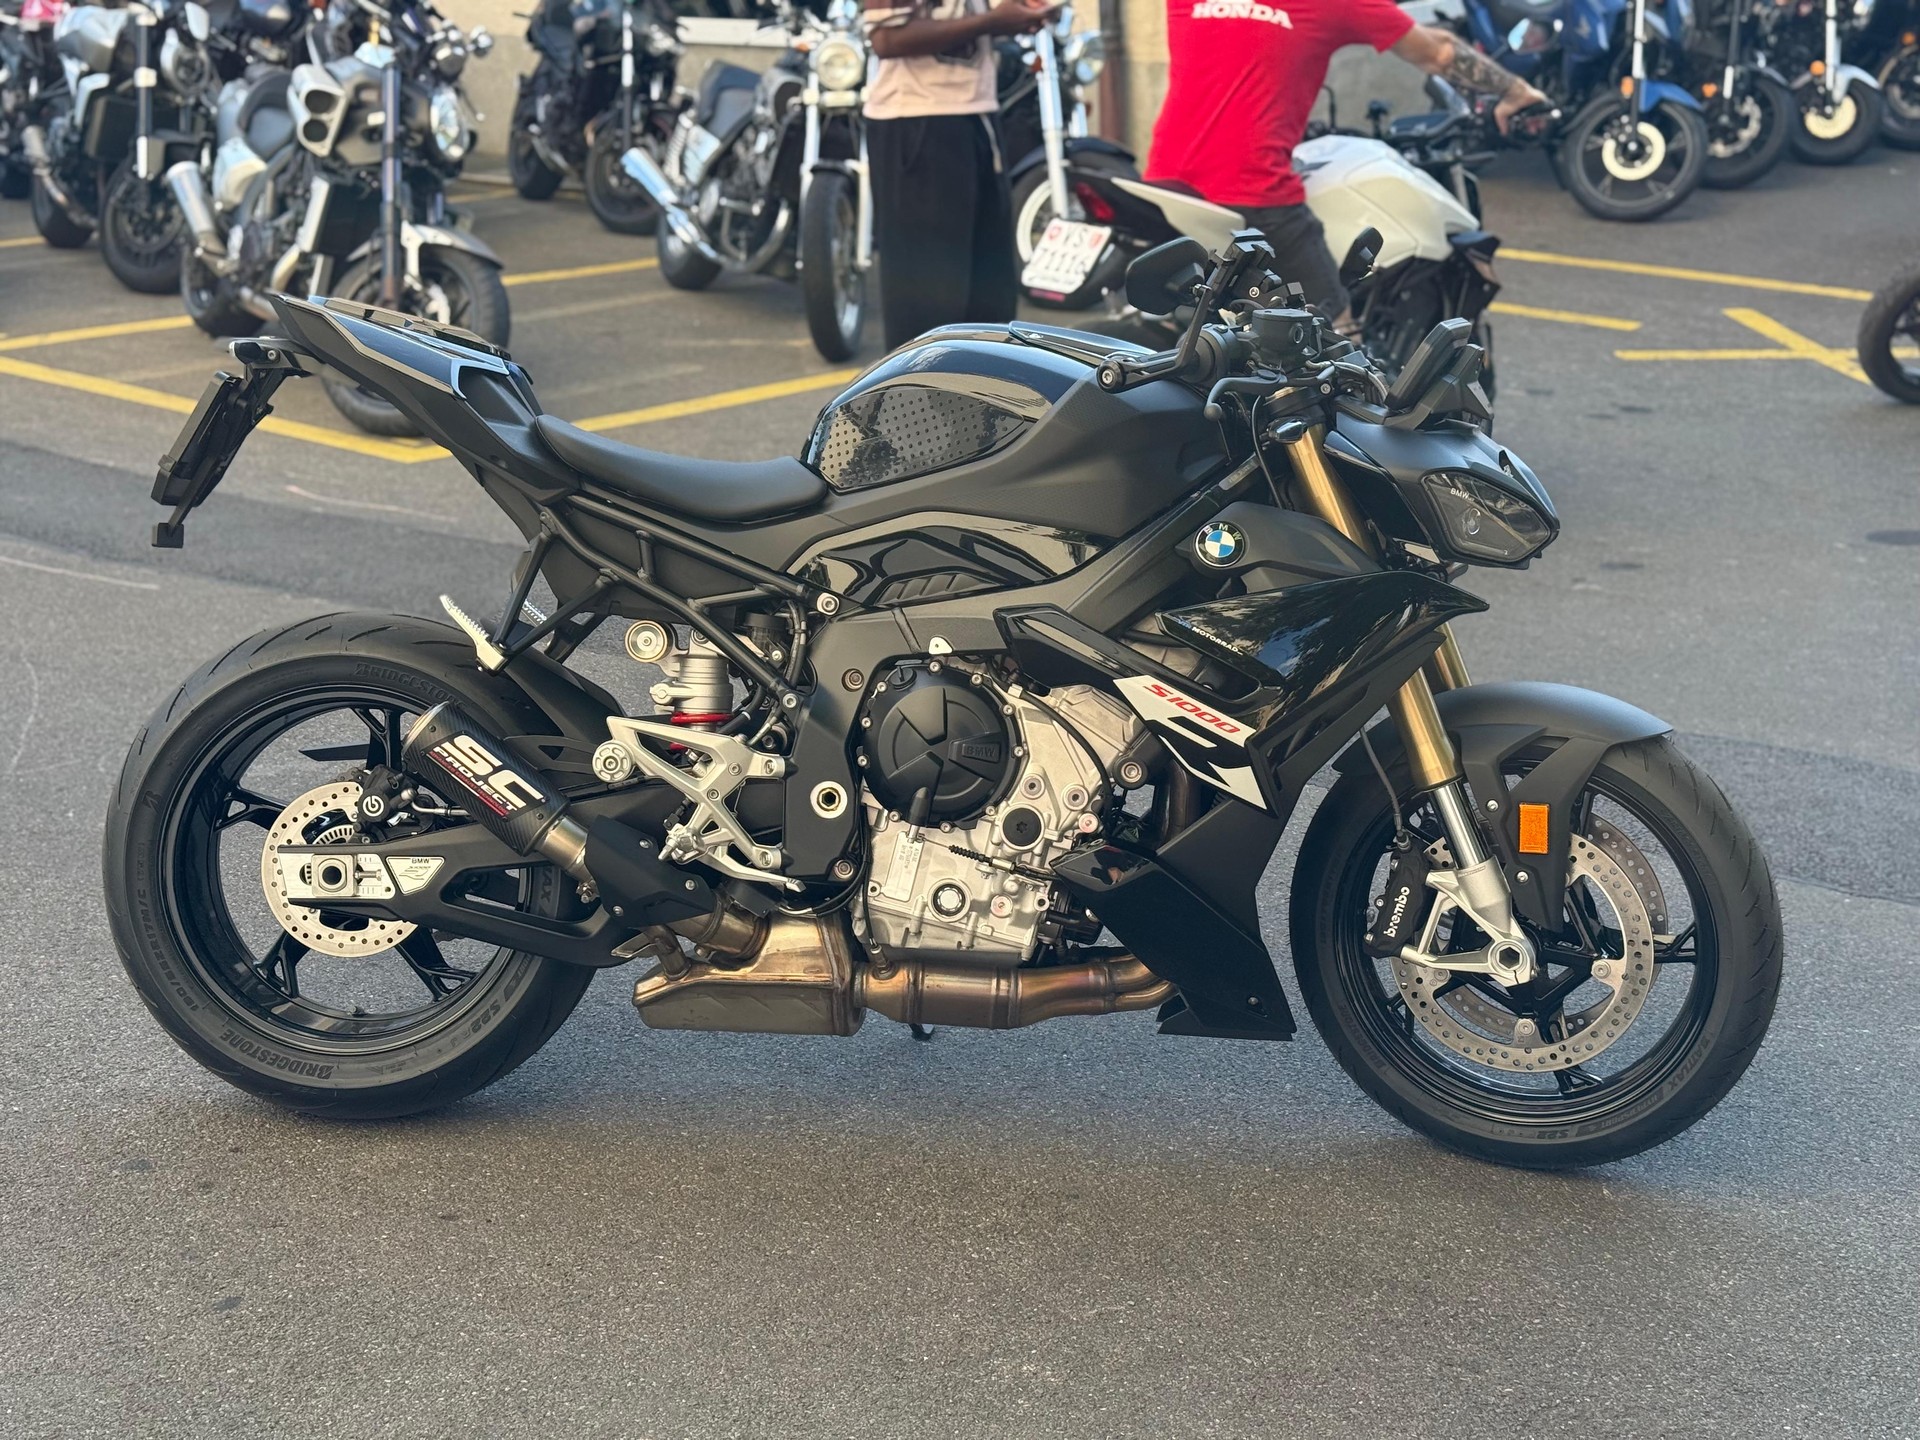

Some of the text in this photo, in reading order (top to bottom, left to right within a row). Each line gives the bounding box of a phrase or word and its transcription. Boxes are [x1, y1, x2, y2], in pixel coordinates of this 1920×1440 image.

[1191, 2, 1294, 30] HONDA
[1450, 487, 1469, 500] BMW
[1203, 523, 1243, 541] BMW
[1191, 626, 1239, 653] MOTORRAD
[966, 745, 995, 757] BMW
[432, 746, 518, 811] PROJECT
[441, 734, 544, 809] SC
[1383, 886, 1411, 938] brembo
[219, 1028, 335, 1080] BRIDGESTONE
